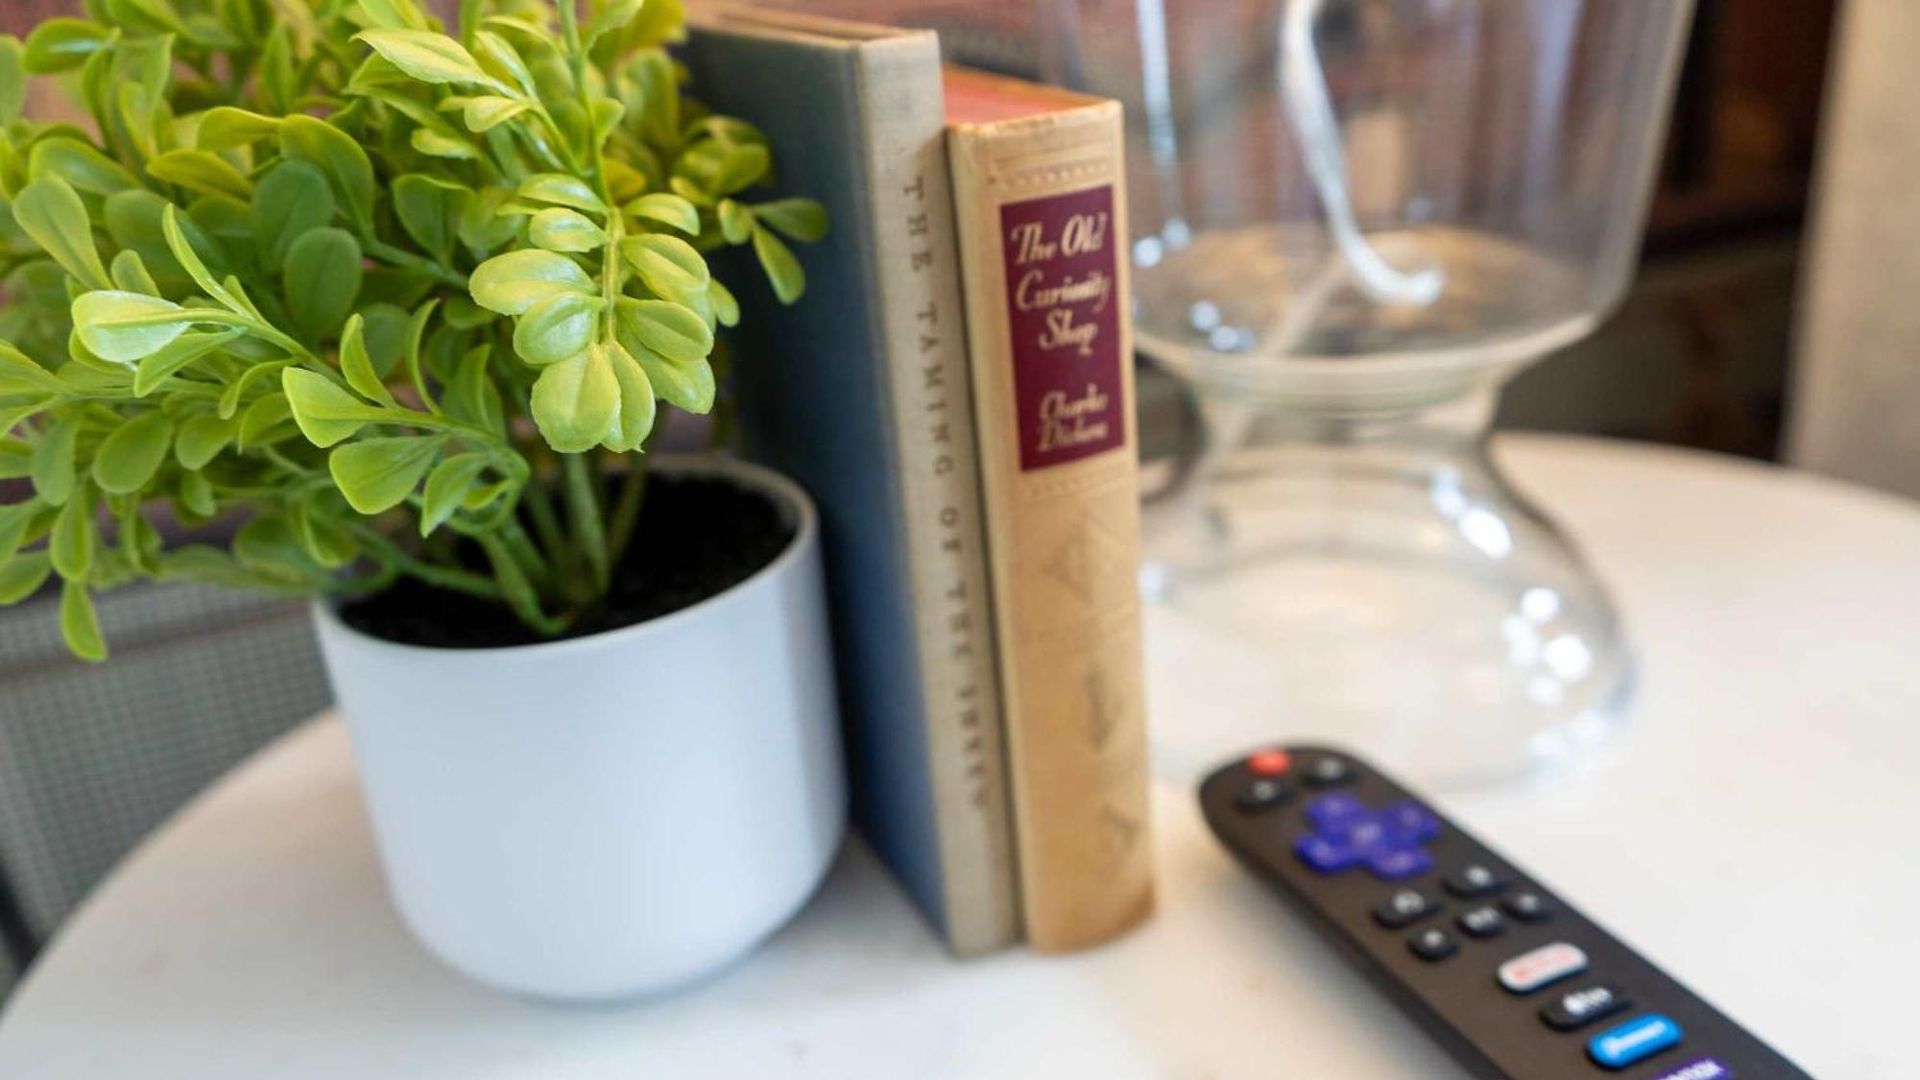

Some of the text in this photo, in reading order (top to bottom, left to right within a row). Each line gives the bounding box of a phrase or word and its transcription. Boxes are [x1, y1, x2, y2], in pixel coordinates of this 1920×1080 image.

[904, 176, 933, 274] THE
[1010, 212, 1108, 265] The Old
[1015, 269, 1112, 314] Curiosity
[1038, 308, 1098, 356] Shop
[916, 302, 955, 479] TAMING
[1039, 382, 1109, 421] Charles
[1036, 417, 1109, 452] Dickens
[938, 506, 962, 555] OF
[947, 580, 974, 659] THE
